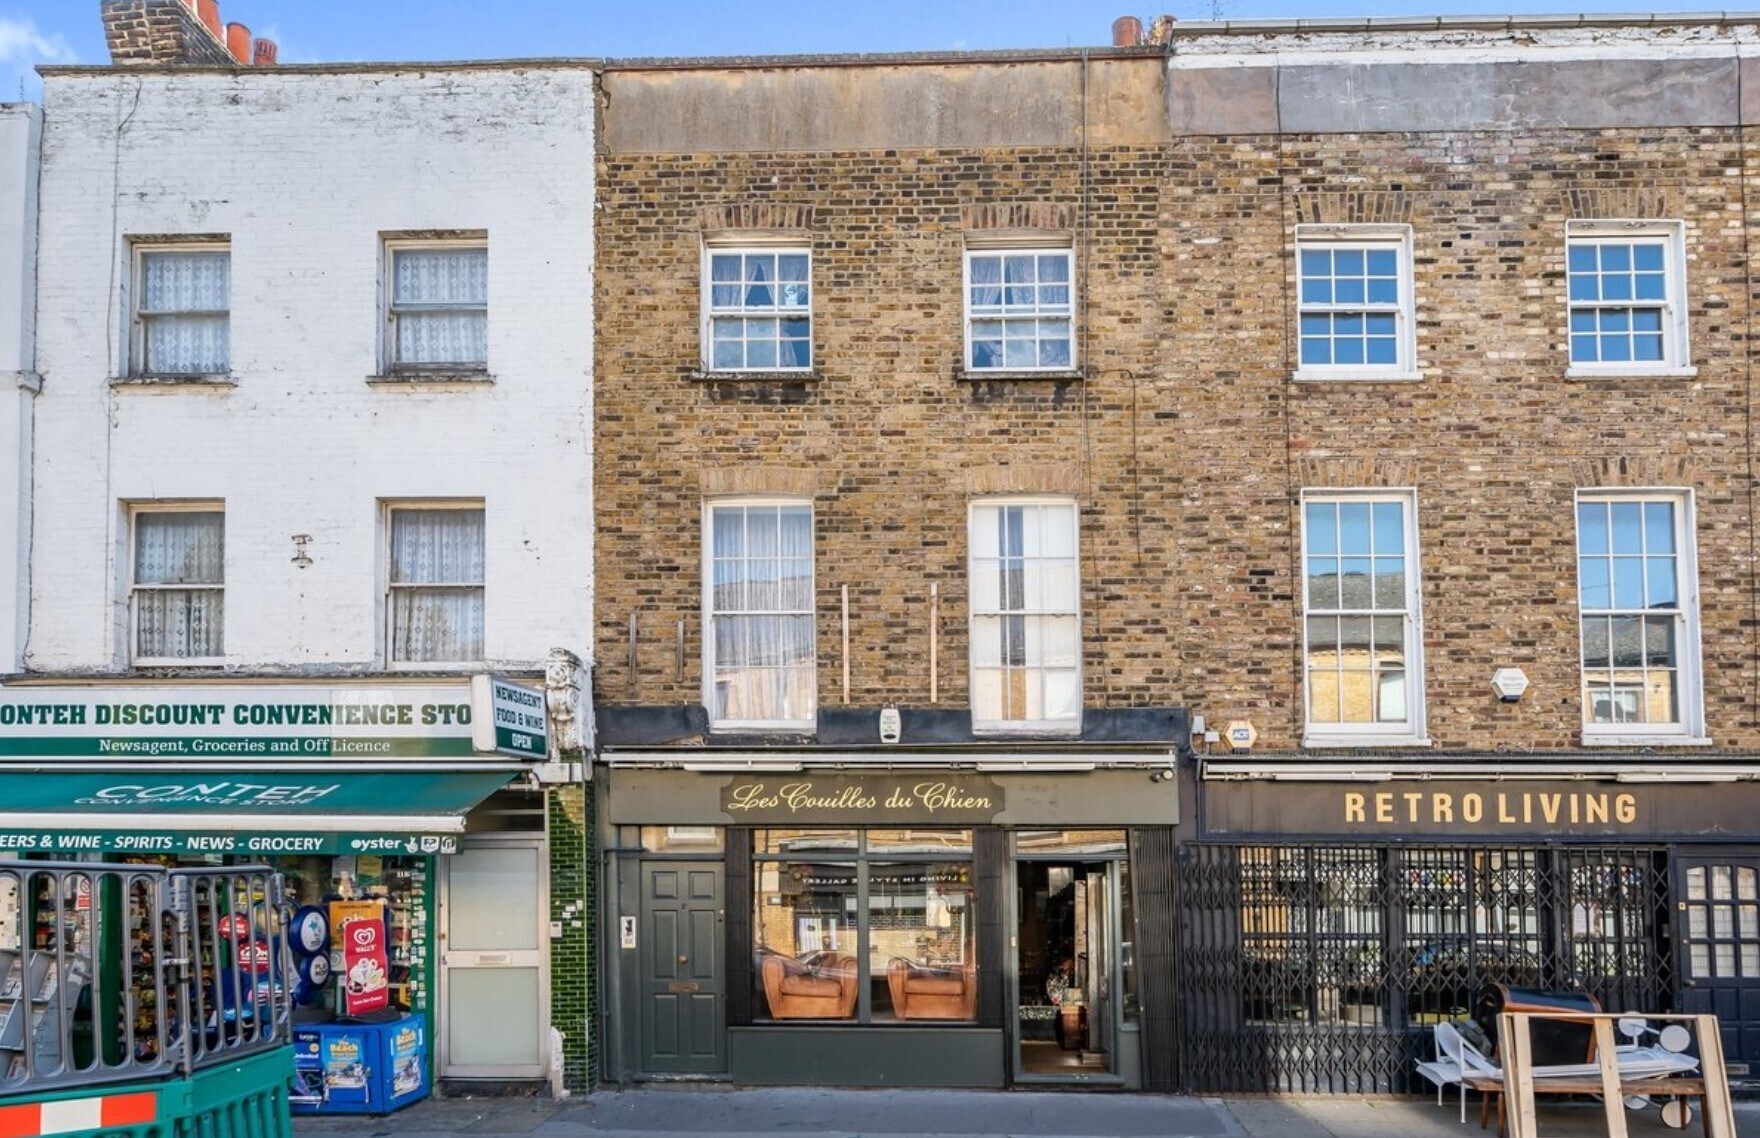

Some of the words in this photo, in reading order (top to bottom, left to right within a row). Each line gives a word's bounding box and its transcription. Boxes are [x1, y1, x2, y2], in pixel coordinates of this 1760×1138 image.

[495, 685, 541, 709] NEWSAGENT
[95, 704, 225, 725] DISCOUNT
[233, 704, 413, 725] CONVENIENCE
[496, 707, 517, 724] FOOD
[524, 714, 544, 730] WINE
[98, 739, 188, 754] Newsagent,
[192, 739, 266, 752] Groceries
[270, 739, 299, 752] and
[304, 738, 330, 752] Off
[332, 739, 391, 752] Licence
[512, 733, 532, 749] OPEN
[96, 782, 341, 800] CONTEH
[728, 784, 779, 812] Les
[779, 783, 876, 812] Couilles
[885, 786, 913, 809] du
[912, 782, 992, 813] Chien
[1345, 793, 1483, 822] RETRO
[1498, 793, 1636, 823] LIVING
[40, 835, 52, 848] &
[58, 835, 102, 849] WINE
[114, 836, 173, 849] SPIRITS
[187, 836, 235, 850] NEWS
[249, 837, 324, 850] GROCERY
[351, 838, 402, 851] oyster
